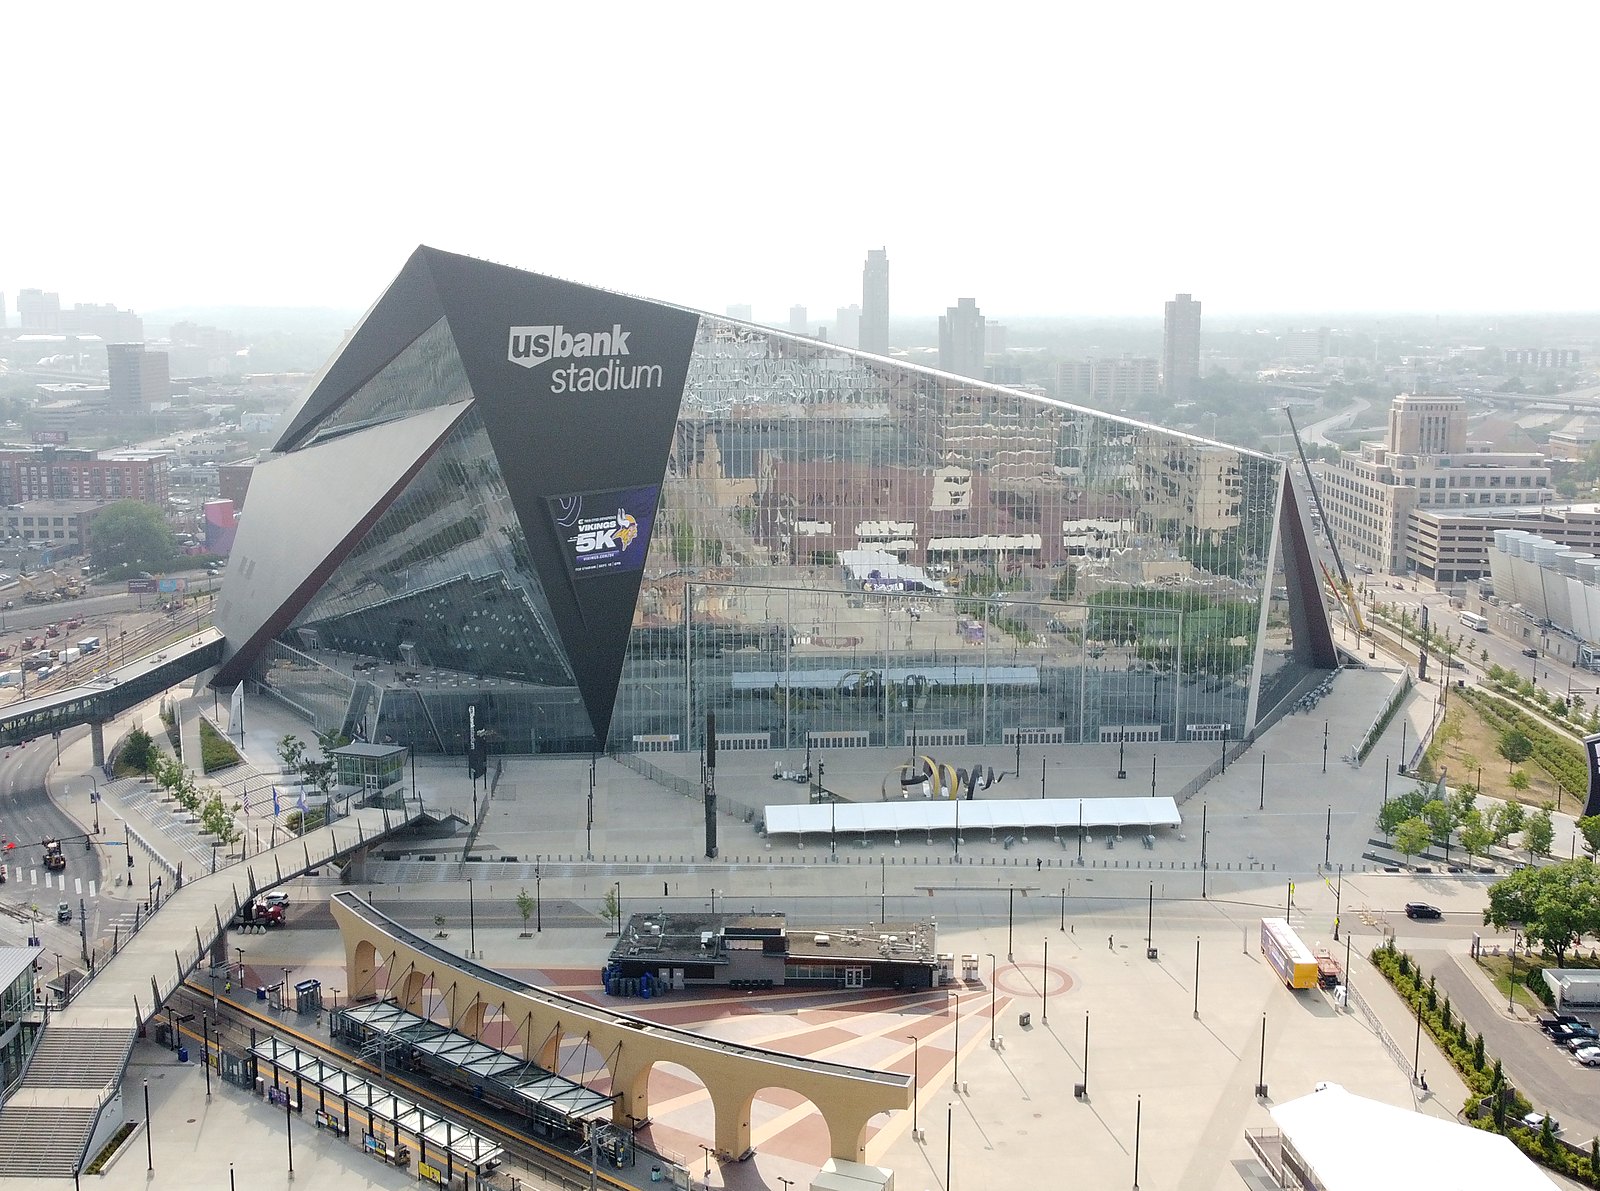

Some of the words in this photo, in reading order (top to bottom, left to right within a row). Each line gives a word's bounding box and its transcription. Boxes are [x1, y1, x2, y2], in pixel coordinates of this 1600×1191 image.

[550, 359, 663, 394] stadium
[578, 520, 617, 532] VIKINGS
[575, 529, 617, 552] 5K
